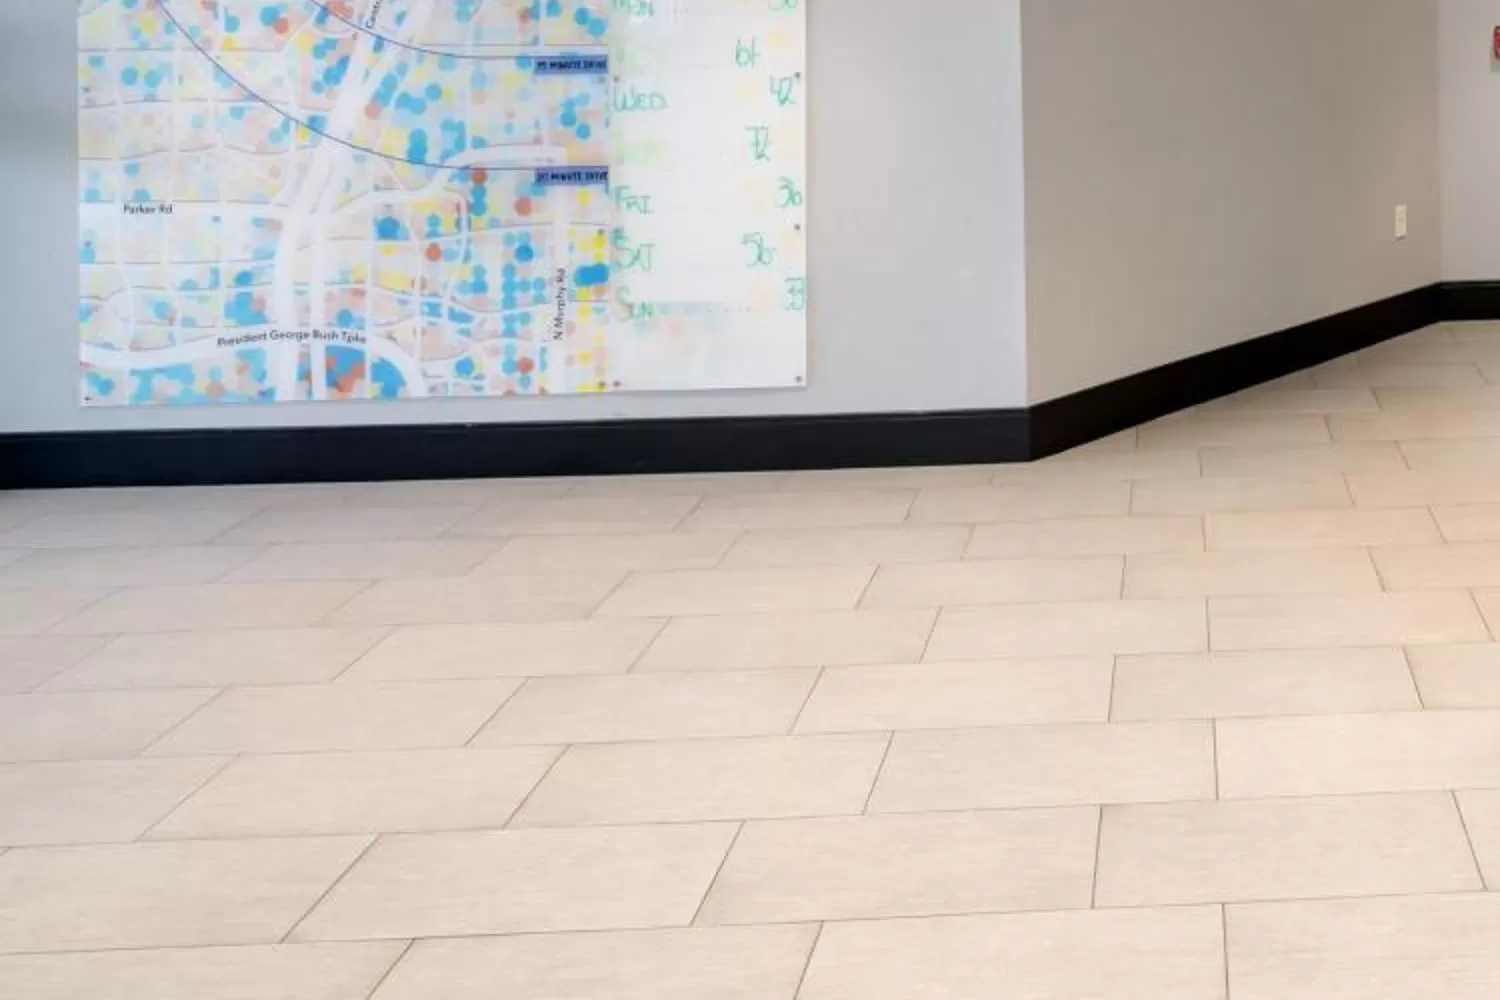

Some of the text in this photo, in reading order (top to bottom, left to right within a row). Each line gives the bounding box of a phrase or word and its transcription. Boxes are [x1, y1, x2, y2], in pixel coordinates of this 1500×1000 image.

[123, 203, 173, 214] Parker Rd
[553, 286, 567, 329] Murphy
[216, 329, 367, 346] President George Bush Tpke
[552, 331, 564, 341] N
